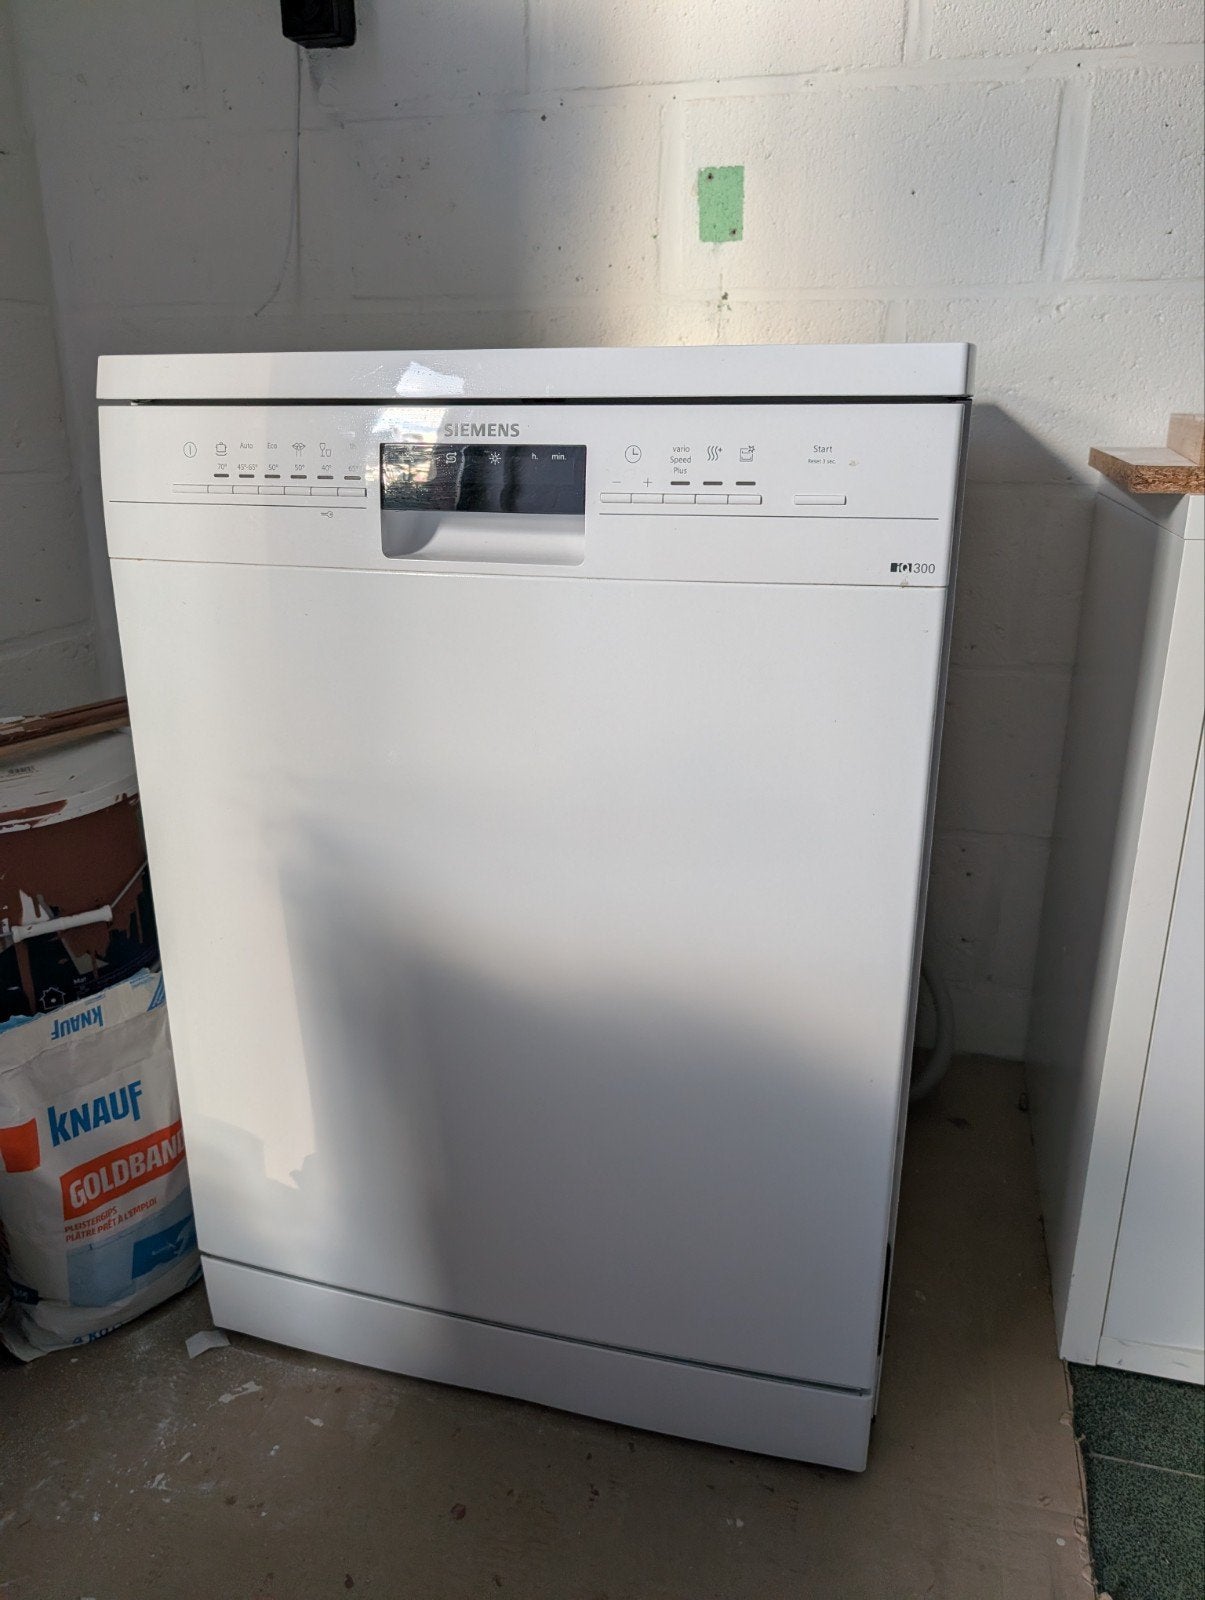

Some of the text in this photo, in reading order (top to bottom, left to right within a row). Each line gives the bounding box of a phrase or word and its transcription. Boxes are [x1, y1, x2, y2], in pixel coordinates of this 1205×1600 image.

[444, 423, 520, 437] SIEMENS
[672, 445, 690, 453] vario
[814, 445, 832, 453] Start
[670, 456, 692, 464] Speed
[674, 466, 687, 474] Plus
[51, 1005, 104, 1040] KNAUF
[47, 1080, 142, 1147] KNAUF
[64, 1206, 118, 1232] PLEISTERGIPS
[66, 1228, 97, 1242] PLÂTRE
[98, 1218, 118, 1234] PRÊT
